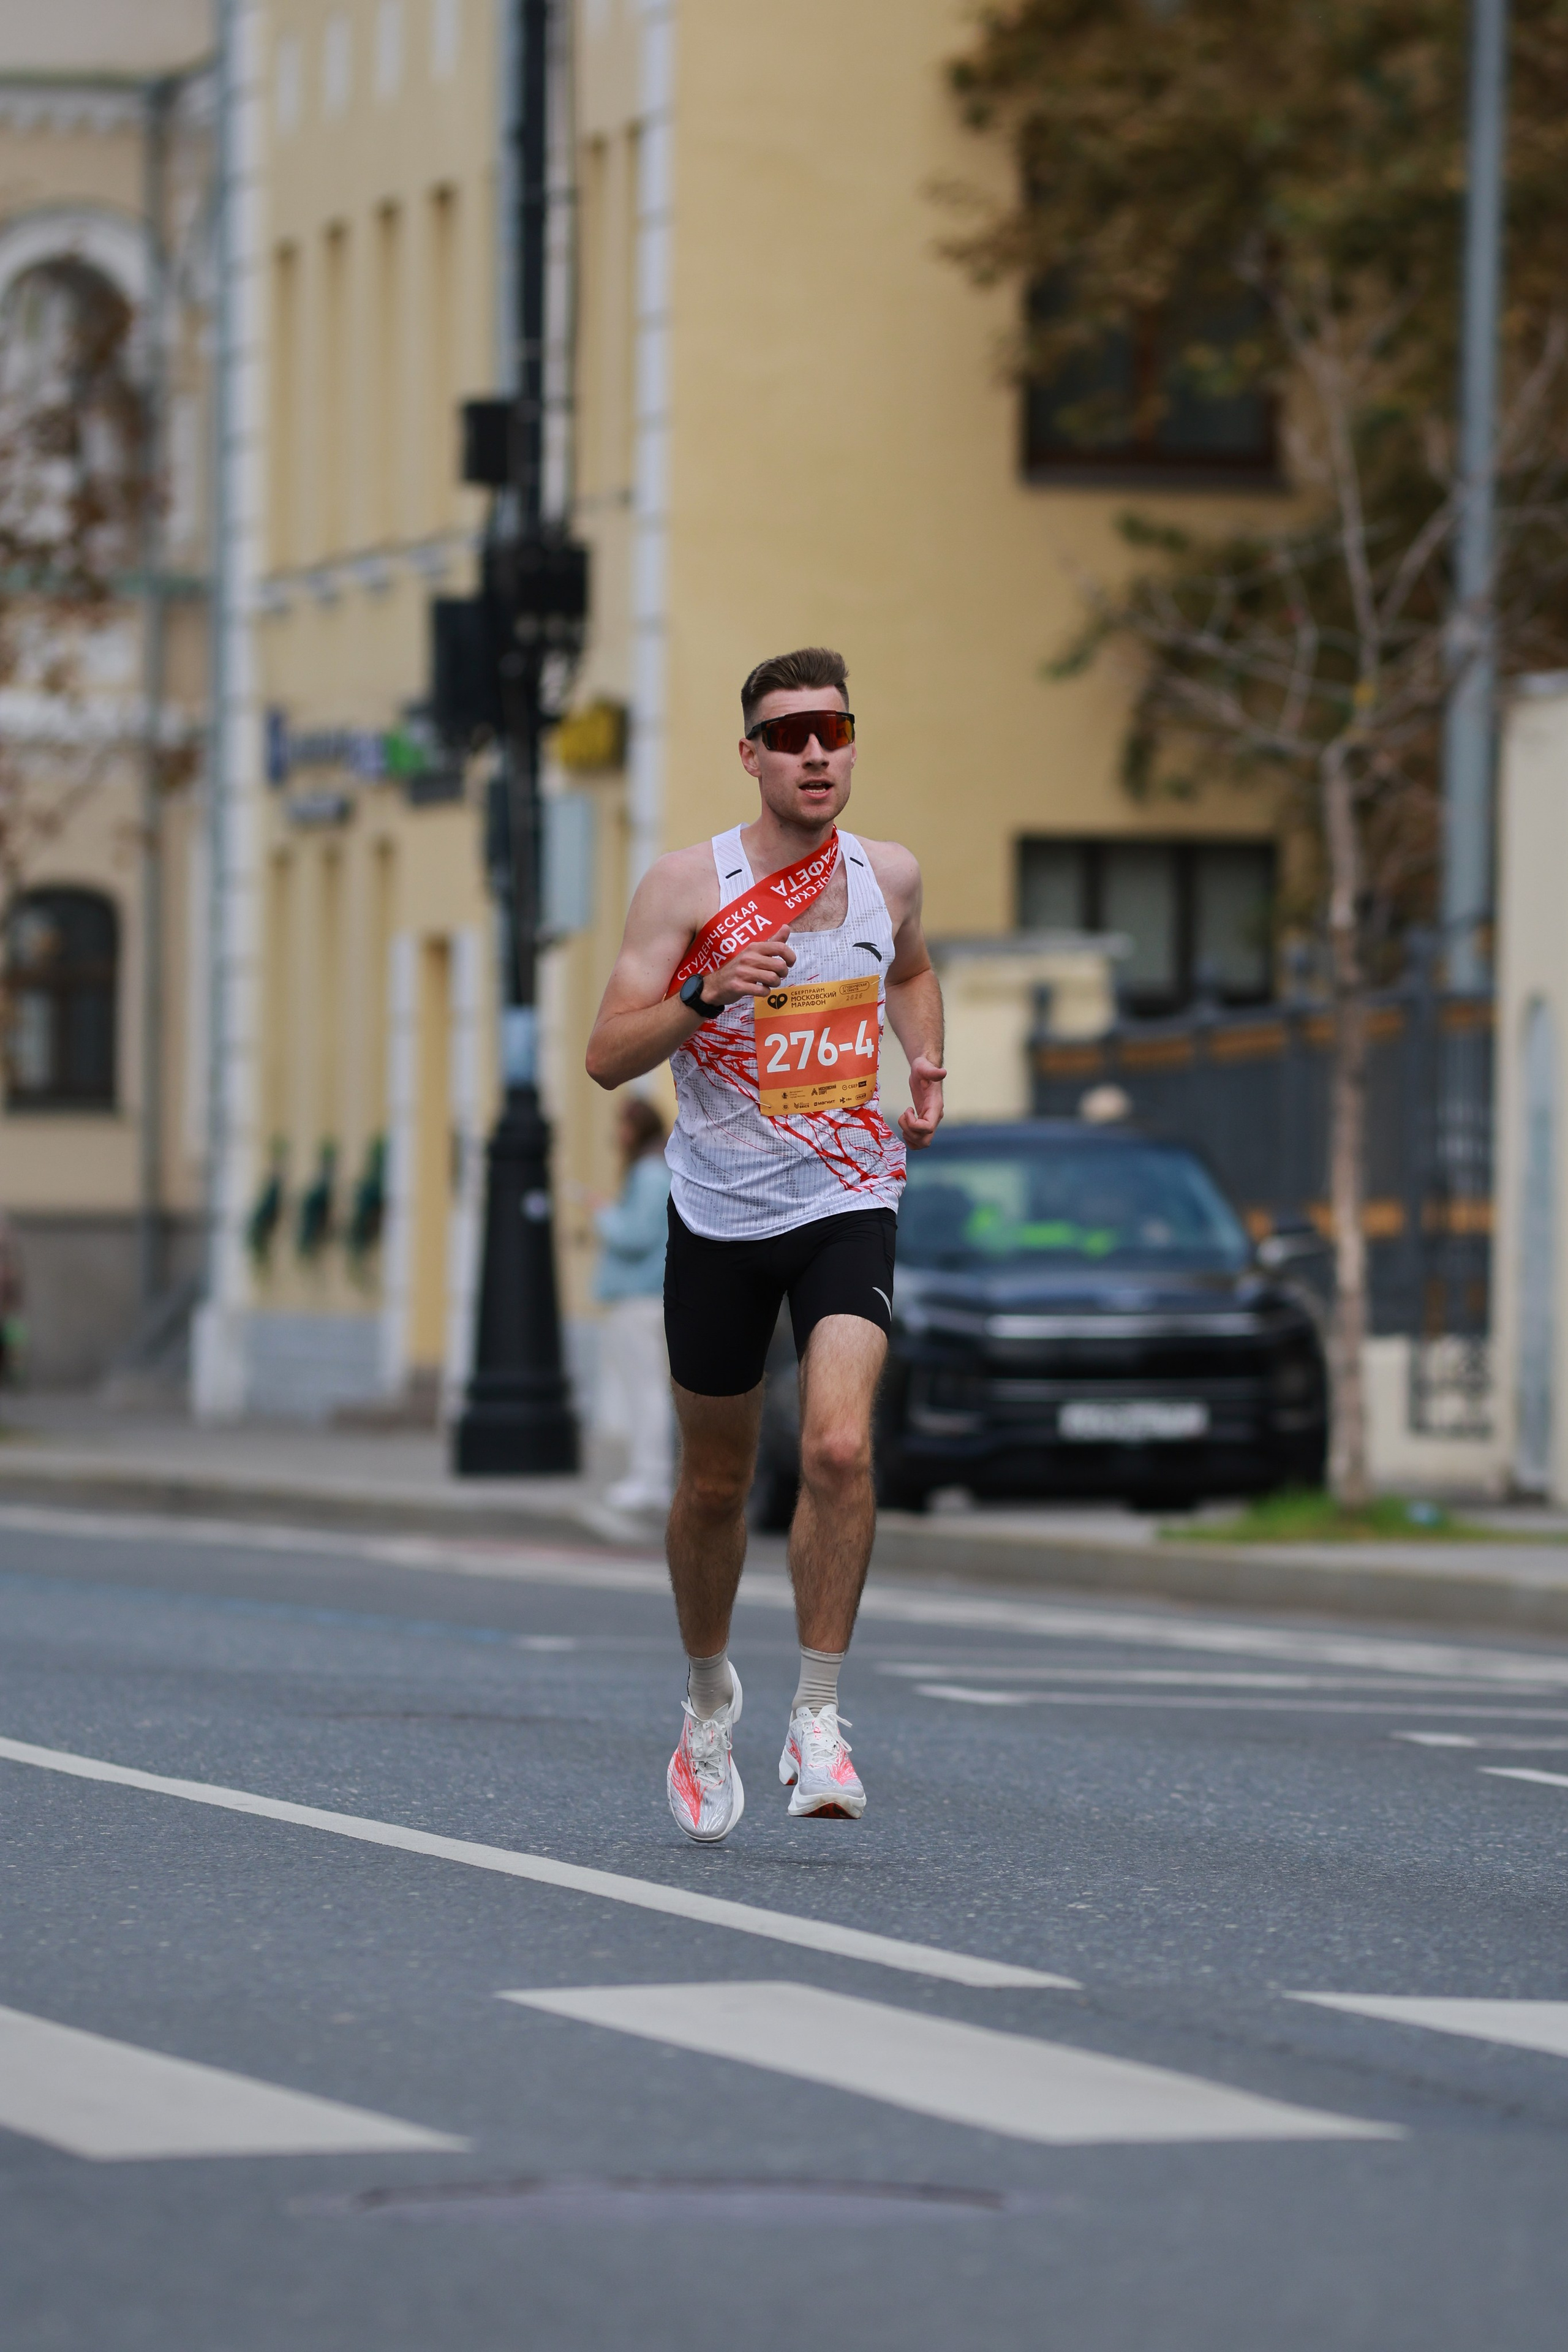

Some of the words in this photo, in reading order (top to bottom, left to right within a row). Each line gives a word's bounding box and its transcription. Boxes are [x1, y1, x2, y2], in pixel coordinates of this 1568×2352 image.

[677, 900, 758, 981] СТУДЕНЧЕСКАЯ
[791, 987, 825, 996] СБЕРПРАЙМ
[791, 990, 837, 1002] МОСКОВСКИЙ
[791, 999, 826, 1008] МАРАФОН
[764, 1020, 875, 1073] 276-4
